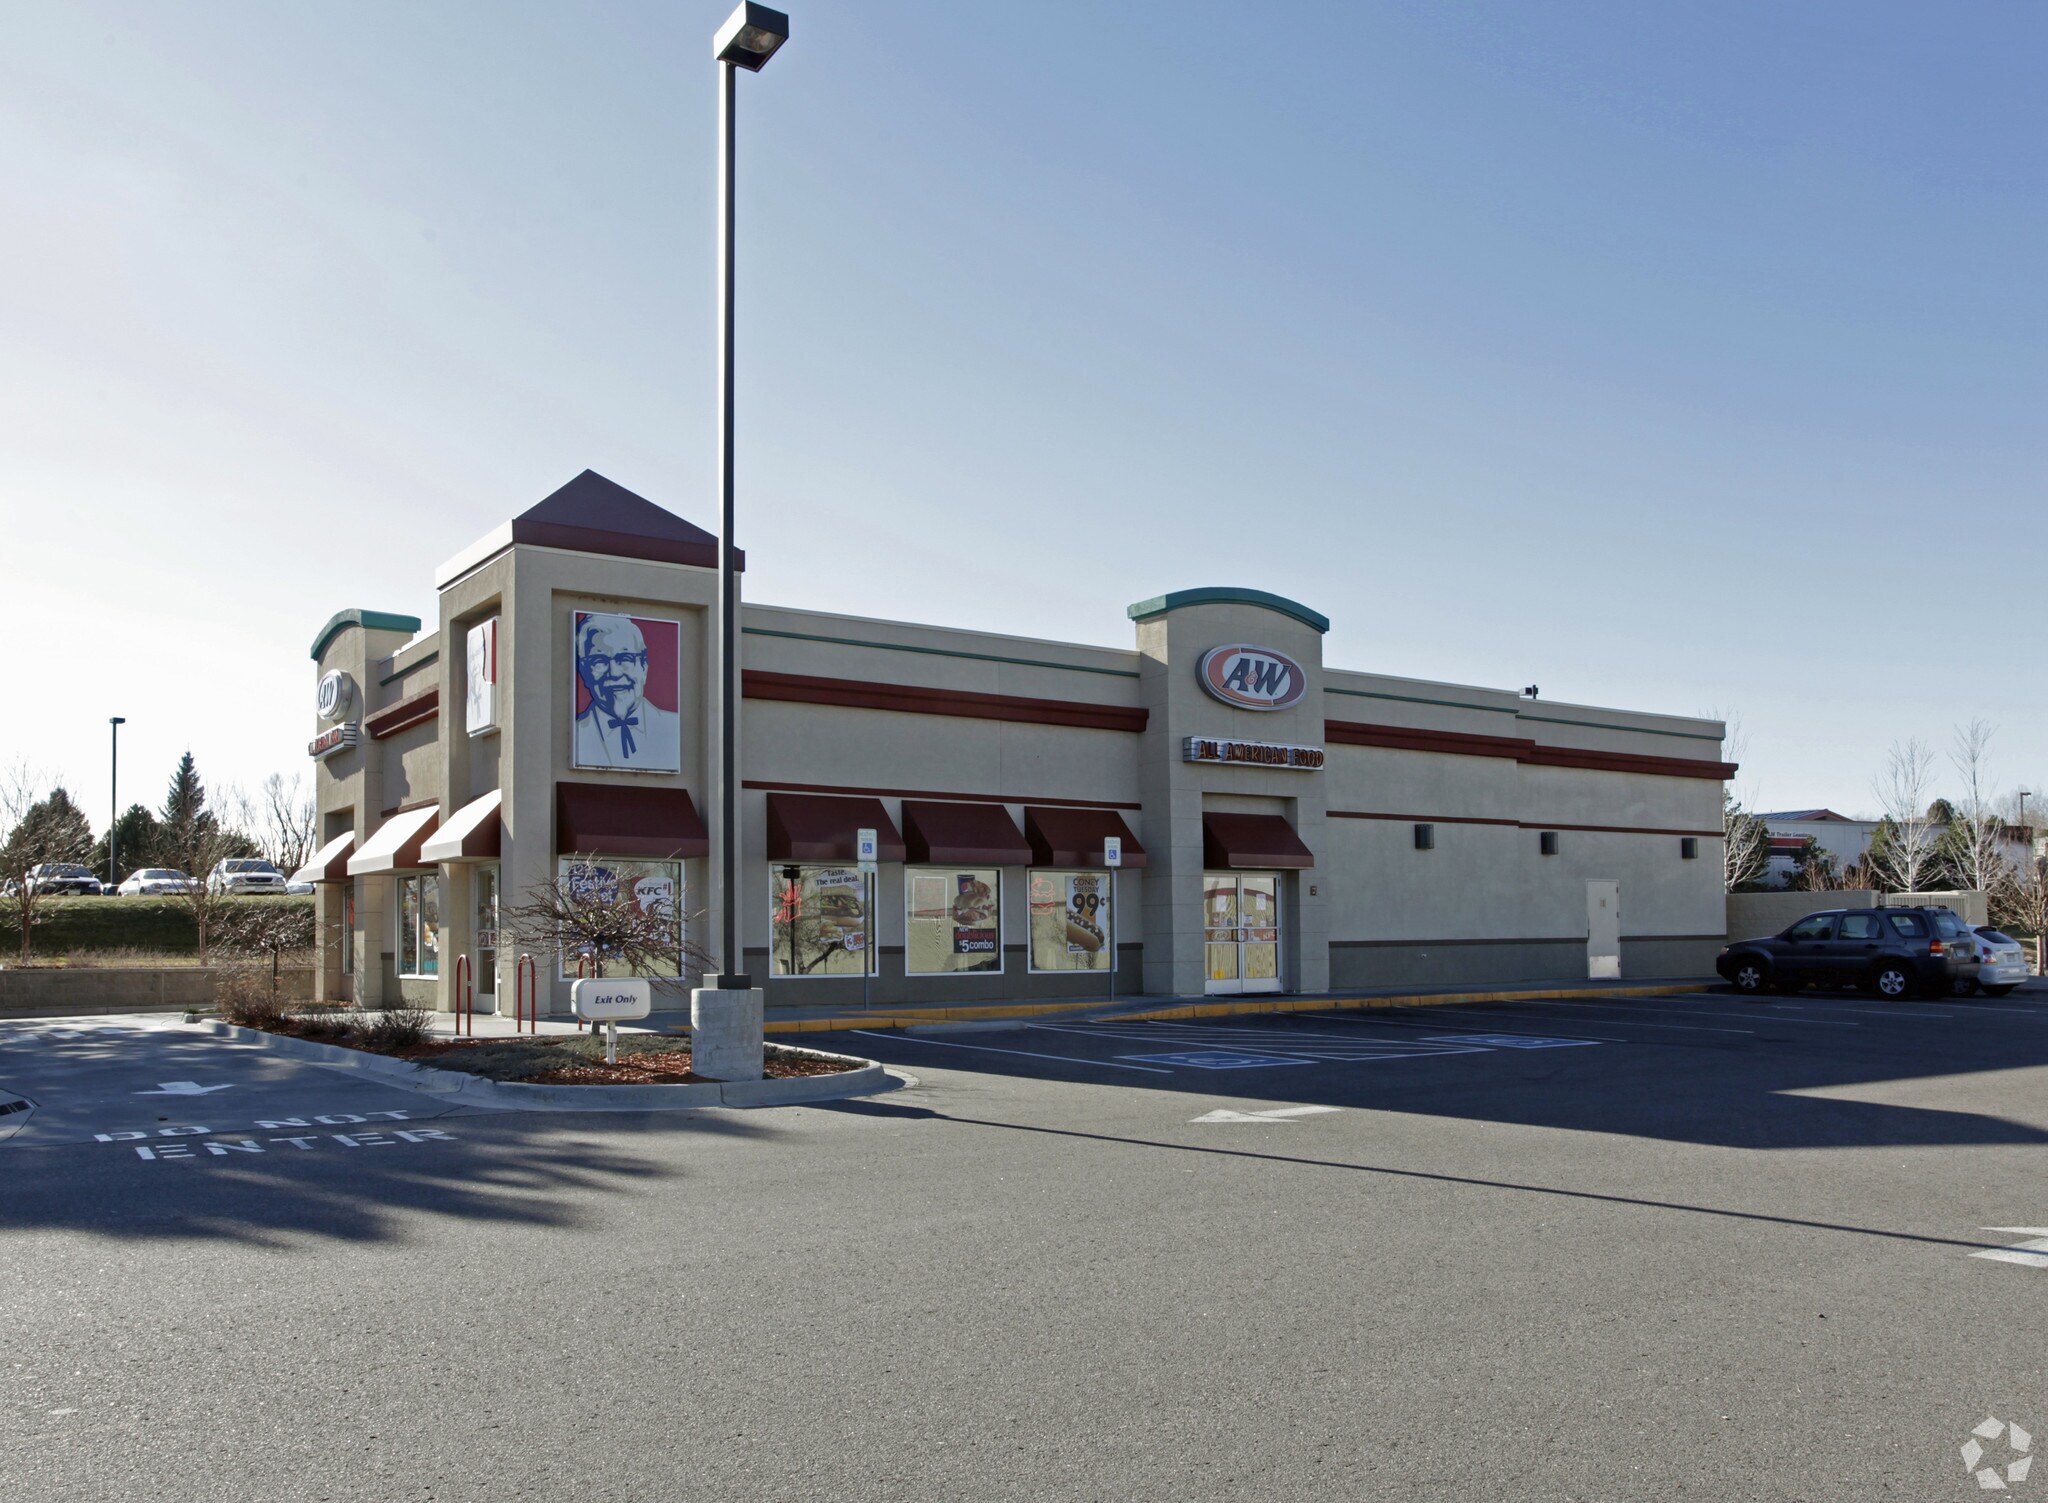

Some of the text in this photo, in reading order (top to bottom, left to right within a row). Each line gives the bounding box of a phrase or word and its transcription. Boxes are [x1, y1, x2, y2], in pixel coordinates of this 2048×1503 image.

[1222, 657, 1292, 696] A&W
[1199, 740, 1324, 768] ALL AMERICAN FOOD
[636, 886, 662, 895] KFC
[969, 939, 994, 949] combo
[595, 994, 638, 1005] Exit Only
[94, 1109, 409, 1142] DO NOT
[134, 1128, 459, 1161] ENTER
